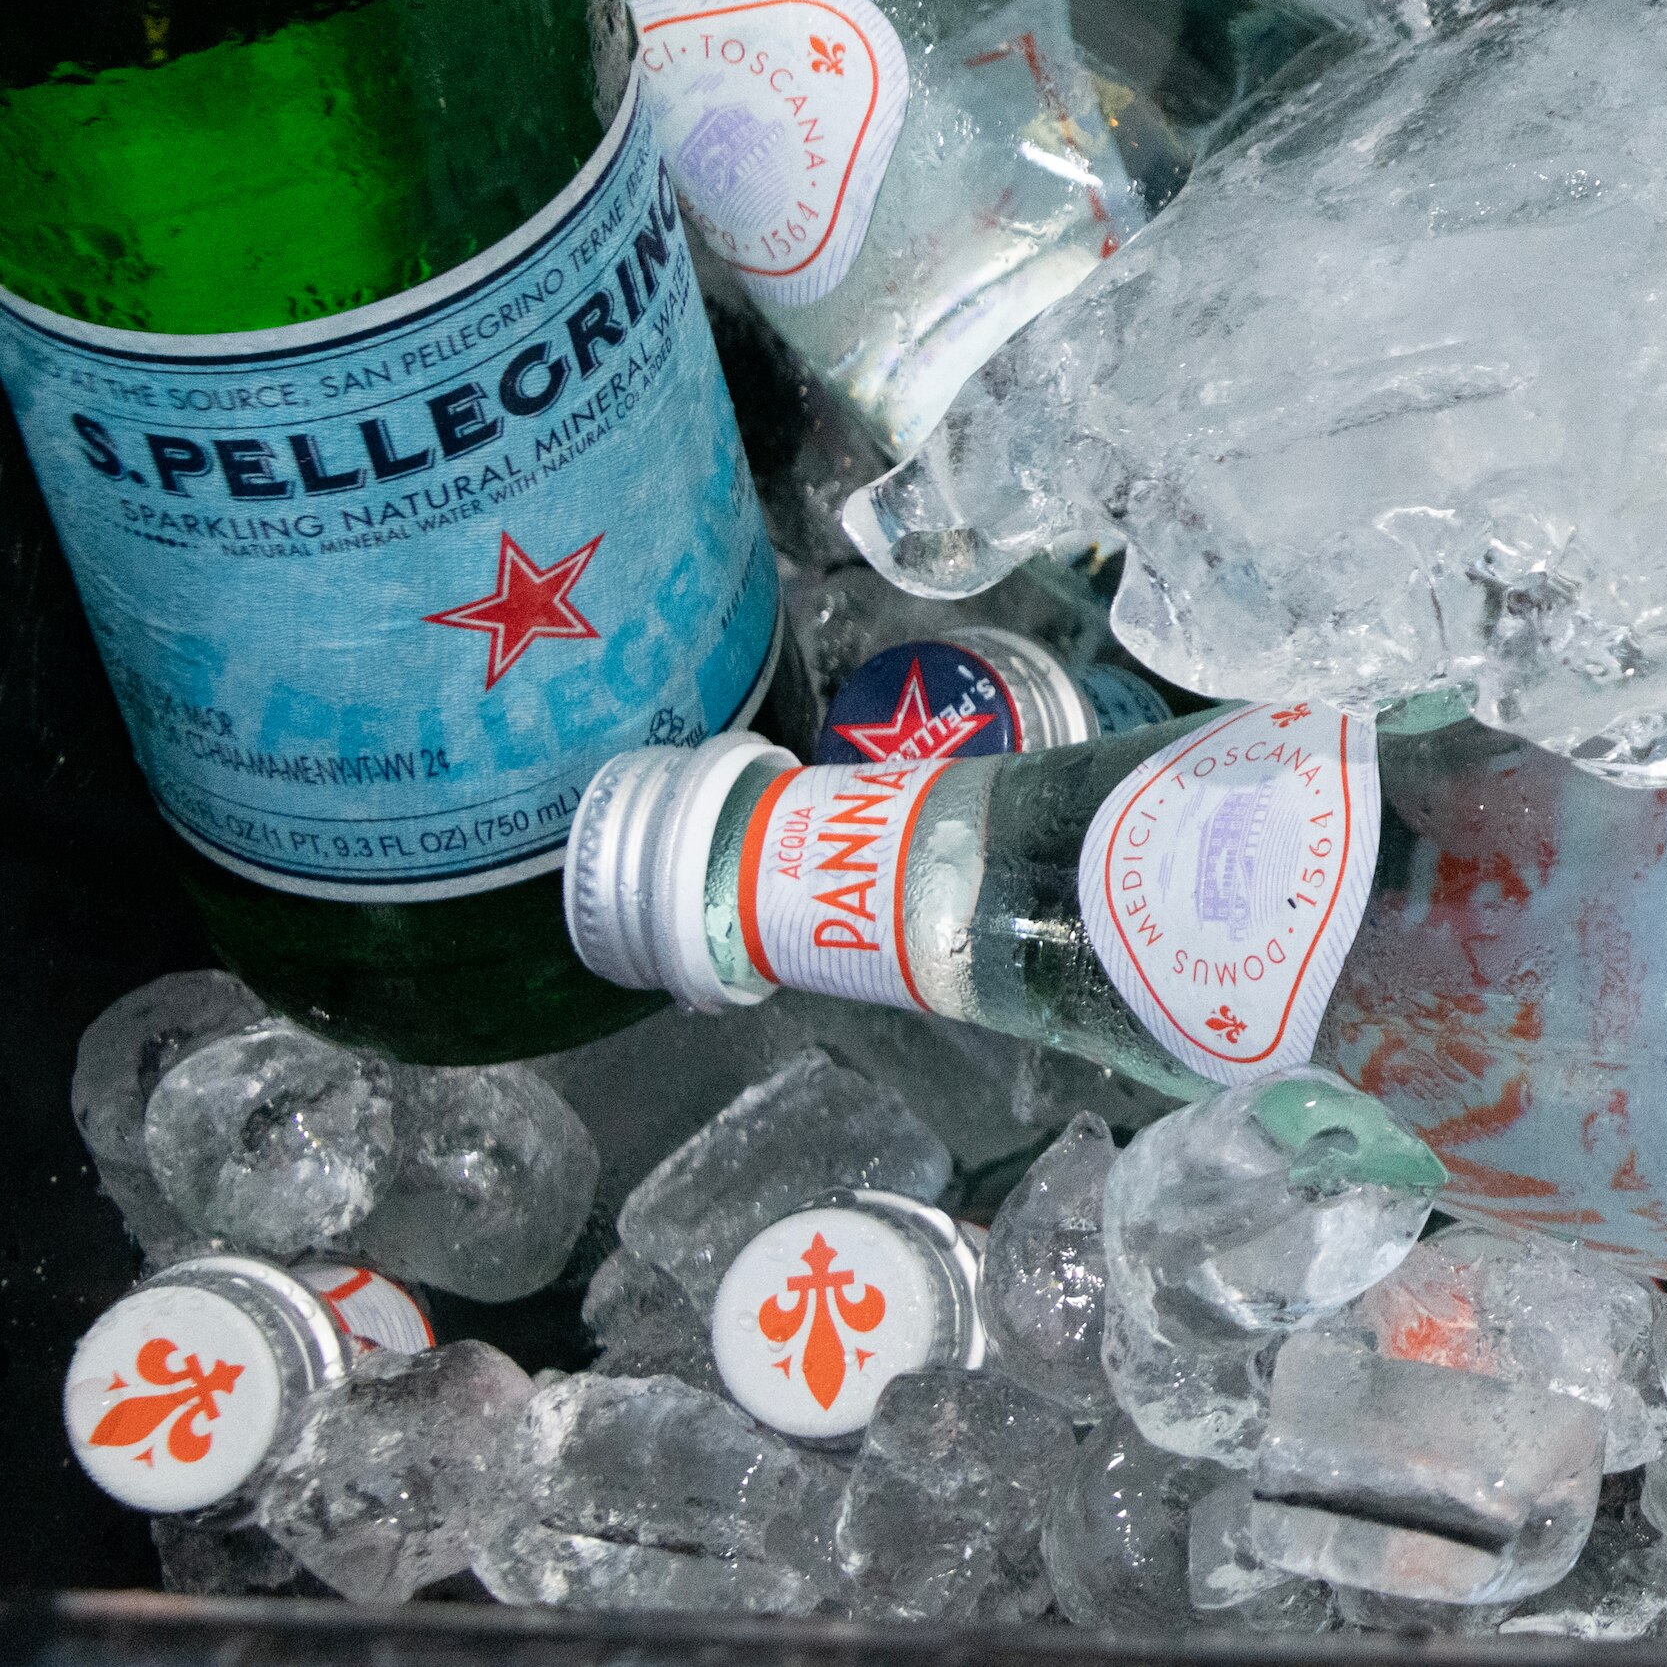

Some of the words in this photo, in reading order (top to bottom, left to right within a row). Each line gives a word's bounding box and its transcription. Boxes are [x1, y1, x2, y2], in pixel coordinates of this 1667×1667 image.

[700, 34, 828, 171] TOSCANA
[760, 200, 820, 261] 1564
[71, 155, 677, 502] S.PELLEGRINO
[105, 377, 160, 409] THE
[319, 360, 393, 398] SAN
[400, 269, 564, 376] PELLEGRINO
[569, 196, 626, 272] TERME
[120, 499, 325, 540] SPARKLING
[341, 454, 522, 528] NATURAL
[534, 341, 651, 463] MINERAL
[653, 242, 686, 337] WATER
[221, 540, 312, 559] NATURAL
[320, 524, 411, 557] MINERAL
[419, 500, 485, 532] WATER
[488, 471, 539, 504] WITH
[542, 420, 614, 478] NATURAL
[643, 337, 673, 391] ADDED
[334, 836, 373, 858] 9.3
[381, 833, 415, 858] FL
[420, 823, 469, 853] OZ)
[474, 808, 530, 846] (750
[1170, 740, 1323, 790] TOSCANA
[777, 805, 816, 881] ACQUA
[812, 765, 920, 952] PANNA
[1122, 810, 1165, 946] MEDICI
[1296, 809, 1334, 907] 1564
[1173, 938, 1287, 987] DOMUS
